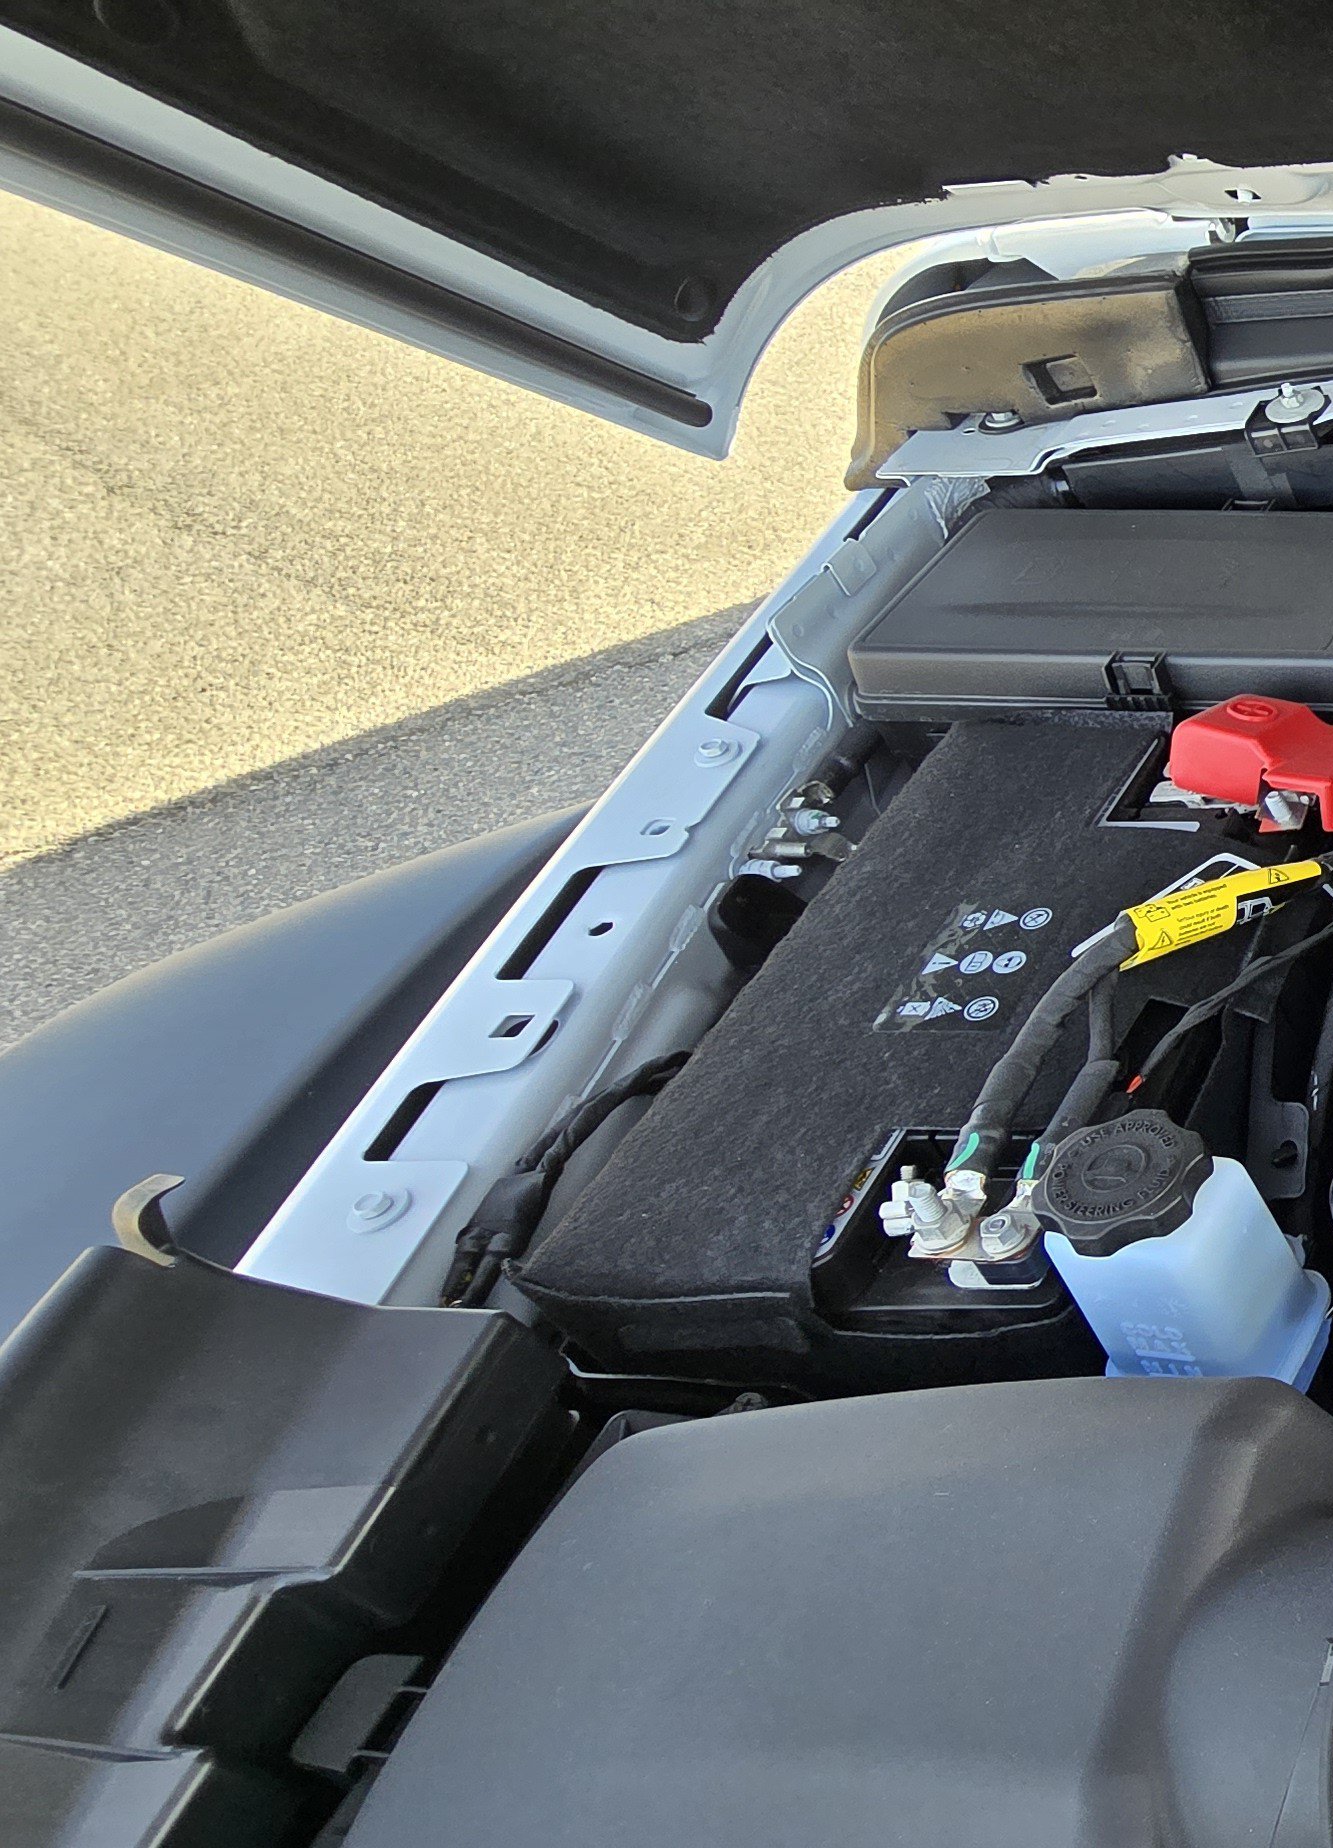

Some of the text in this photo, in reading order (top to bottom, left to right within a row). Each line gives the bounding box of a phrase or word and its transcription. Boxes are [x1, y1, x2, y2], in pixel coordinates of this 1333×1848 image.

[1080, 1120, 1177, 1149] USE APPROVED
[1052, 1163, 1170, 1217] POWER STEERING FLUID
